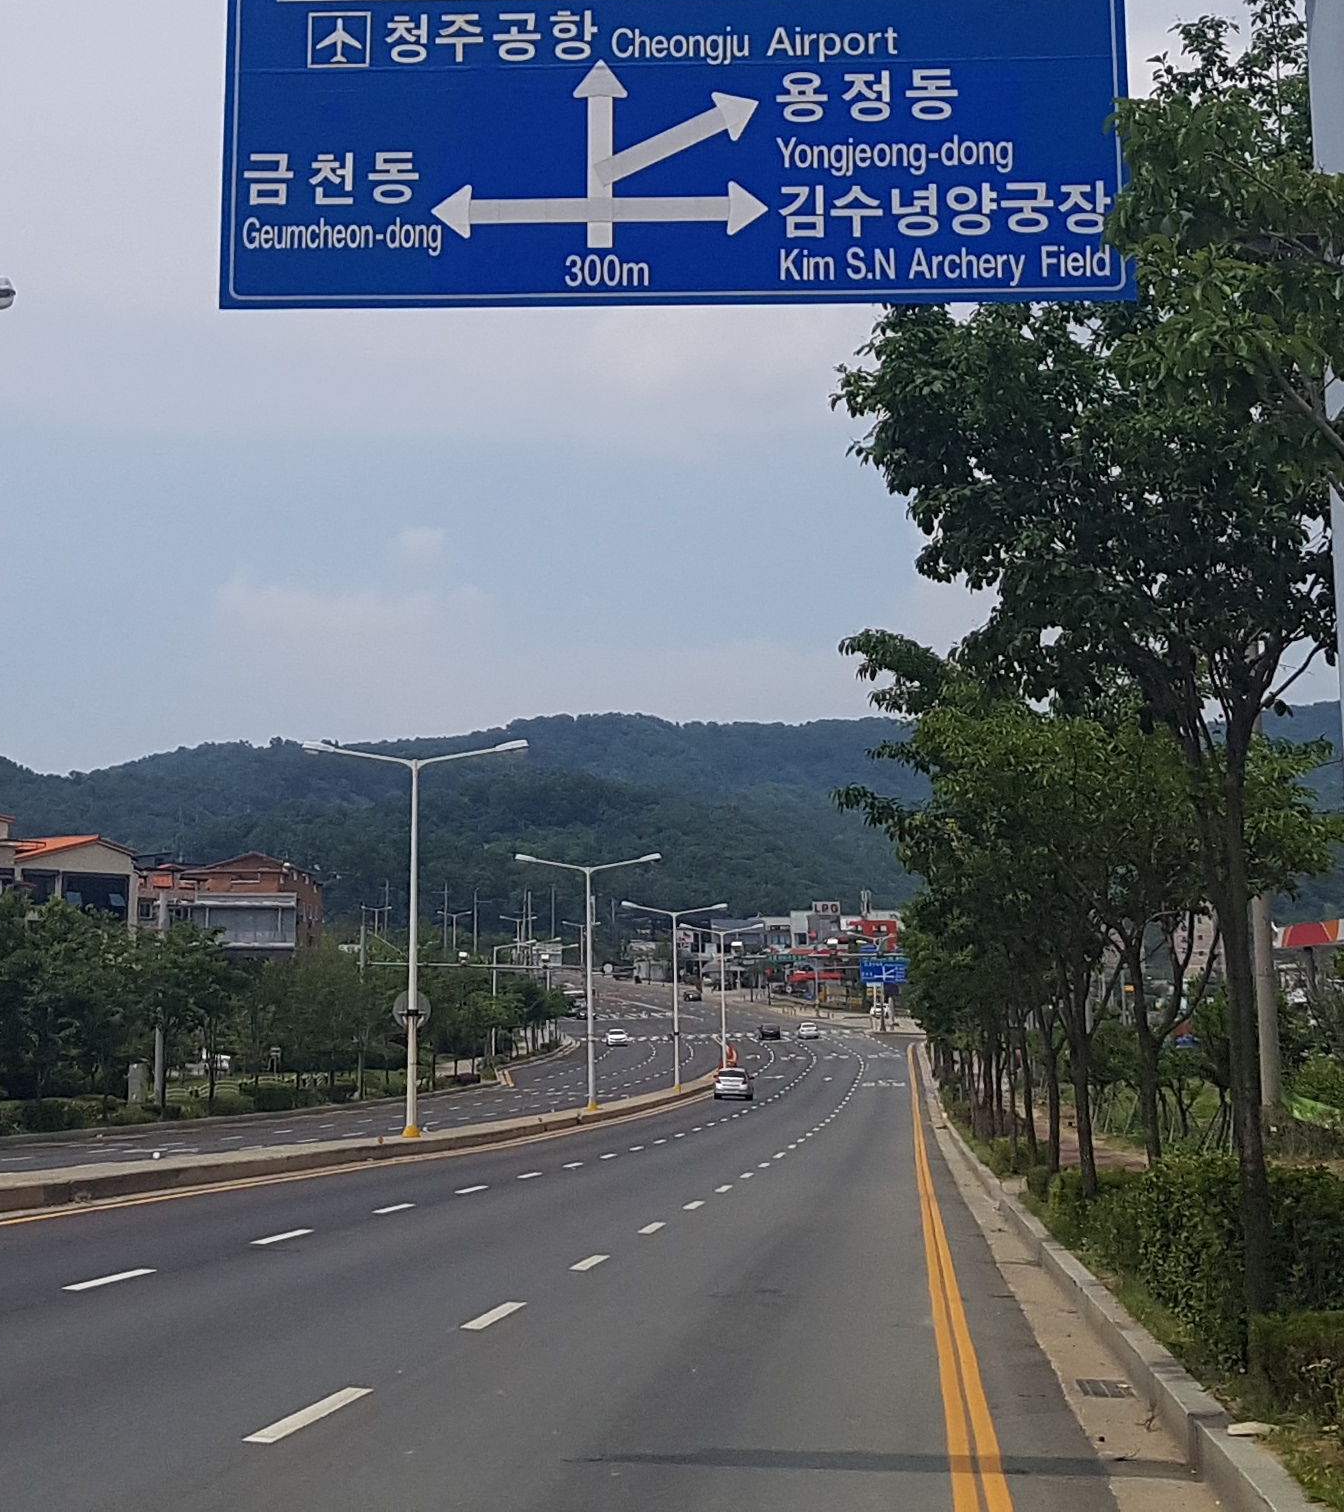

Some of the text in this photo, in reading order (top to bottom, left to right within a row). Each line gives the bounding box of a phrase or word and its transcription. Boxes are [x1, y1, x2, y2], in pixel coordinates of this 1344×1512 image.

[384, 9, 899, 65] 청주공항 Cheongju Airport
[775, 67, 959, 123] 용정동
[242, 150, 420, 206] 금천동
[775, 134, 1014, 177] Yongjeong-dong
[778, 180, 1112, 238] 김수녕양궁장
[242, 216, 443, 256] Geumcheon-dong
[564, 254, 650, 287] 300m
[779, 244, 1112, 286] Kim S.N Archery Field
